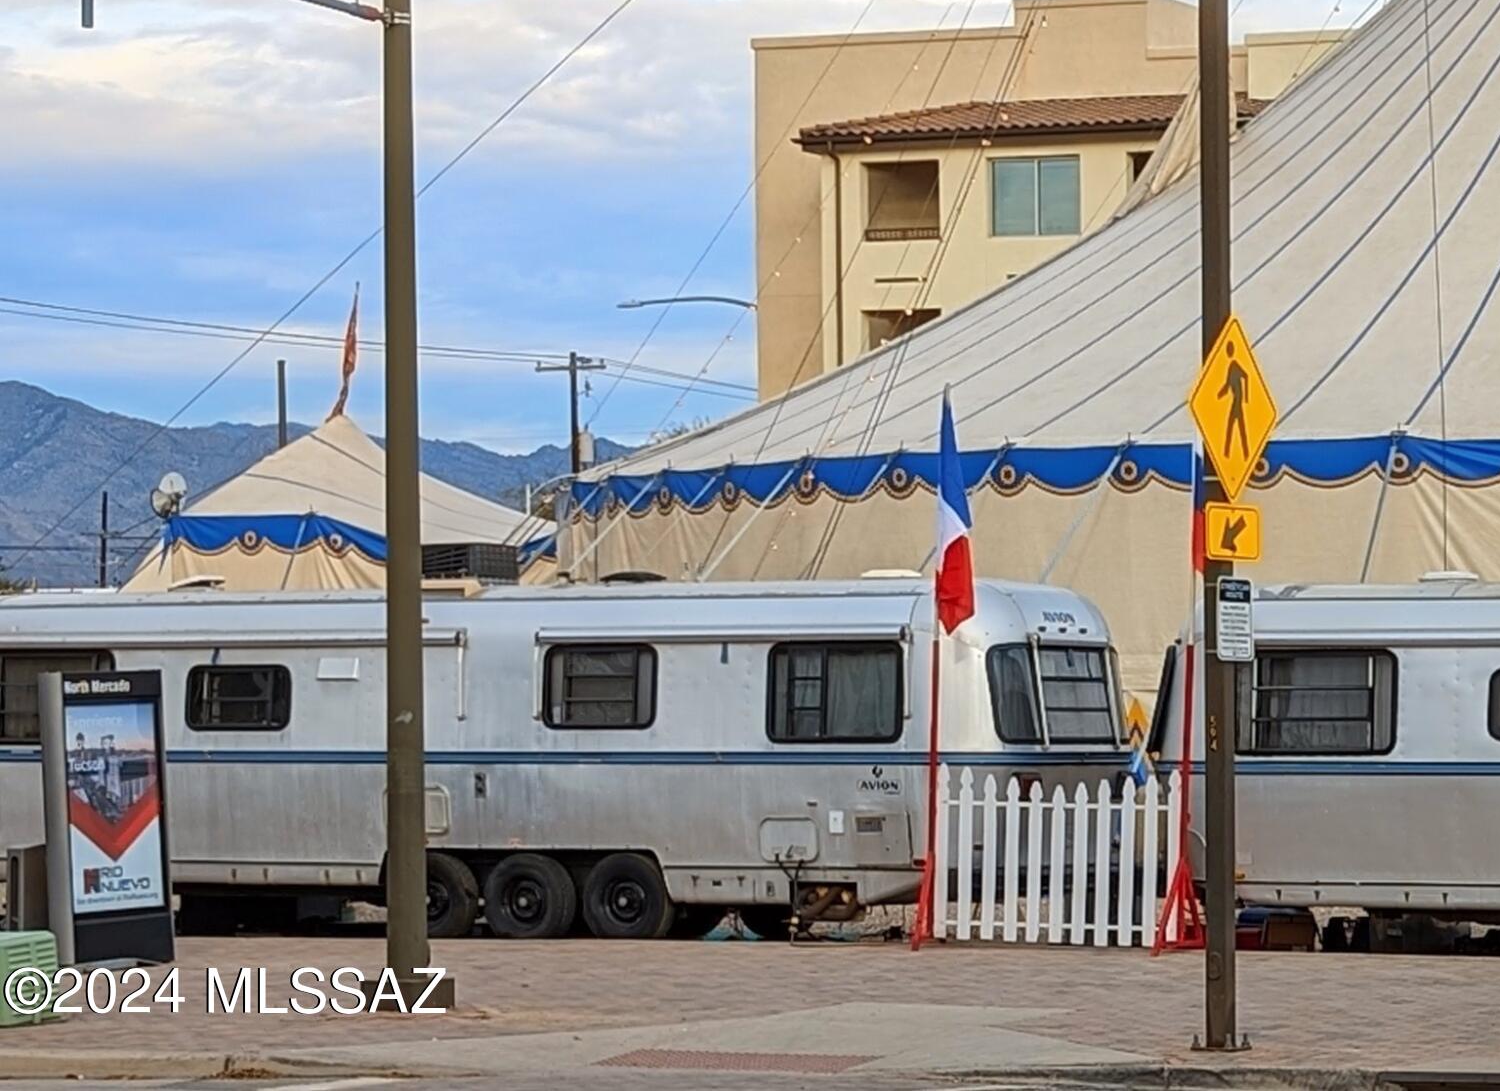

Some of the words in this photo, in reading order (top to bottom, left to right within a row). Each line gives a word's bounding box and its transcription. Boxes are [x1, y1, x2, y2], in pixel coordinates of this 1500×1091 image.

[1042, 611, 1076, 627] AVION
[64, 679, 89, 694] North
[91, 679, 130, 693] Mercado
[68, 758, 105, 772] Tucson
[861, 780, 899, 790] AVION
[101, 866, 124, 878] RIO
[101, 877, 151, 892] NUEVO
